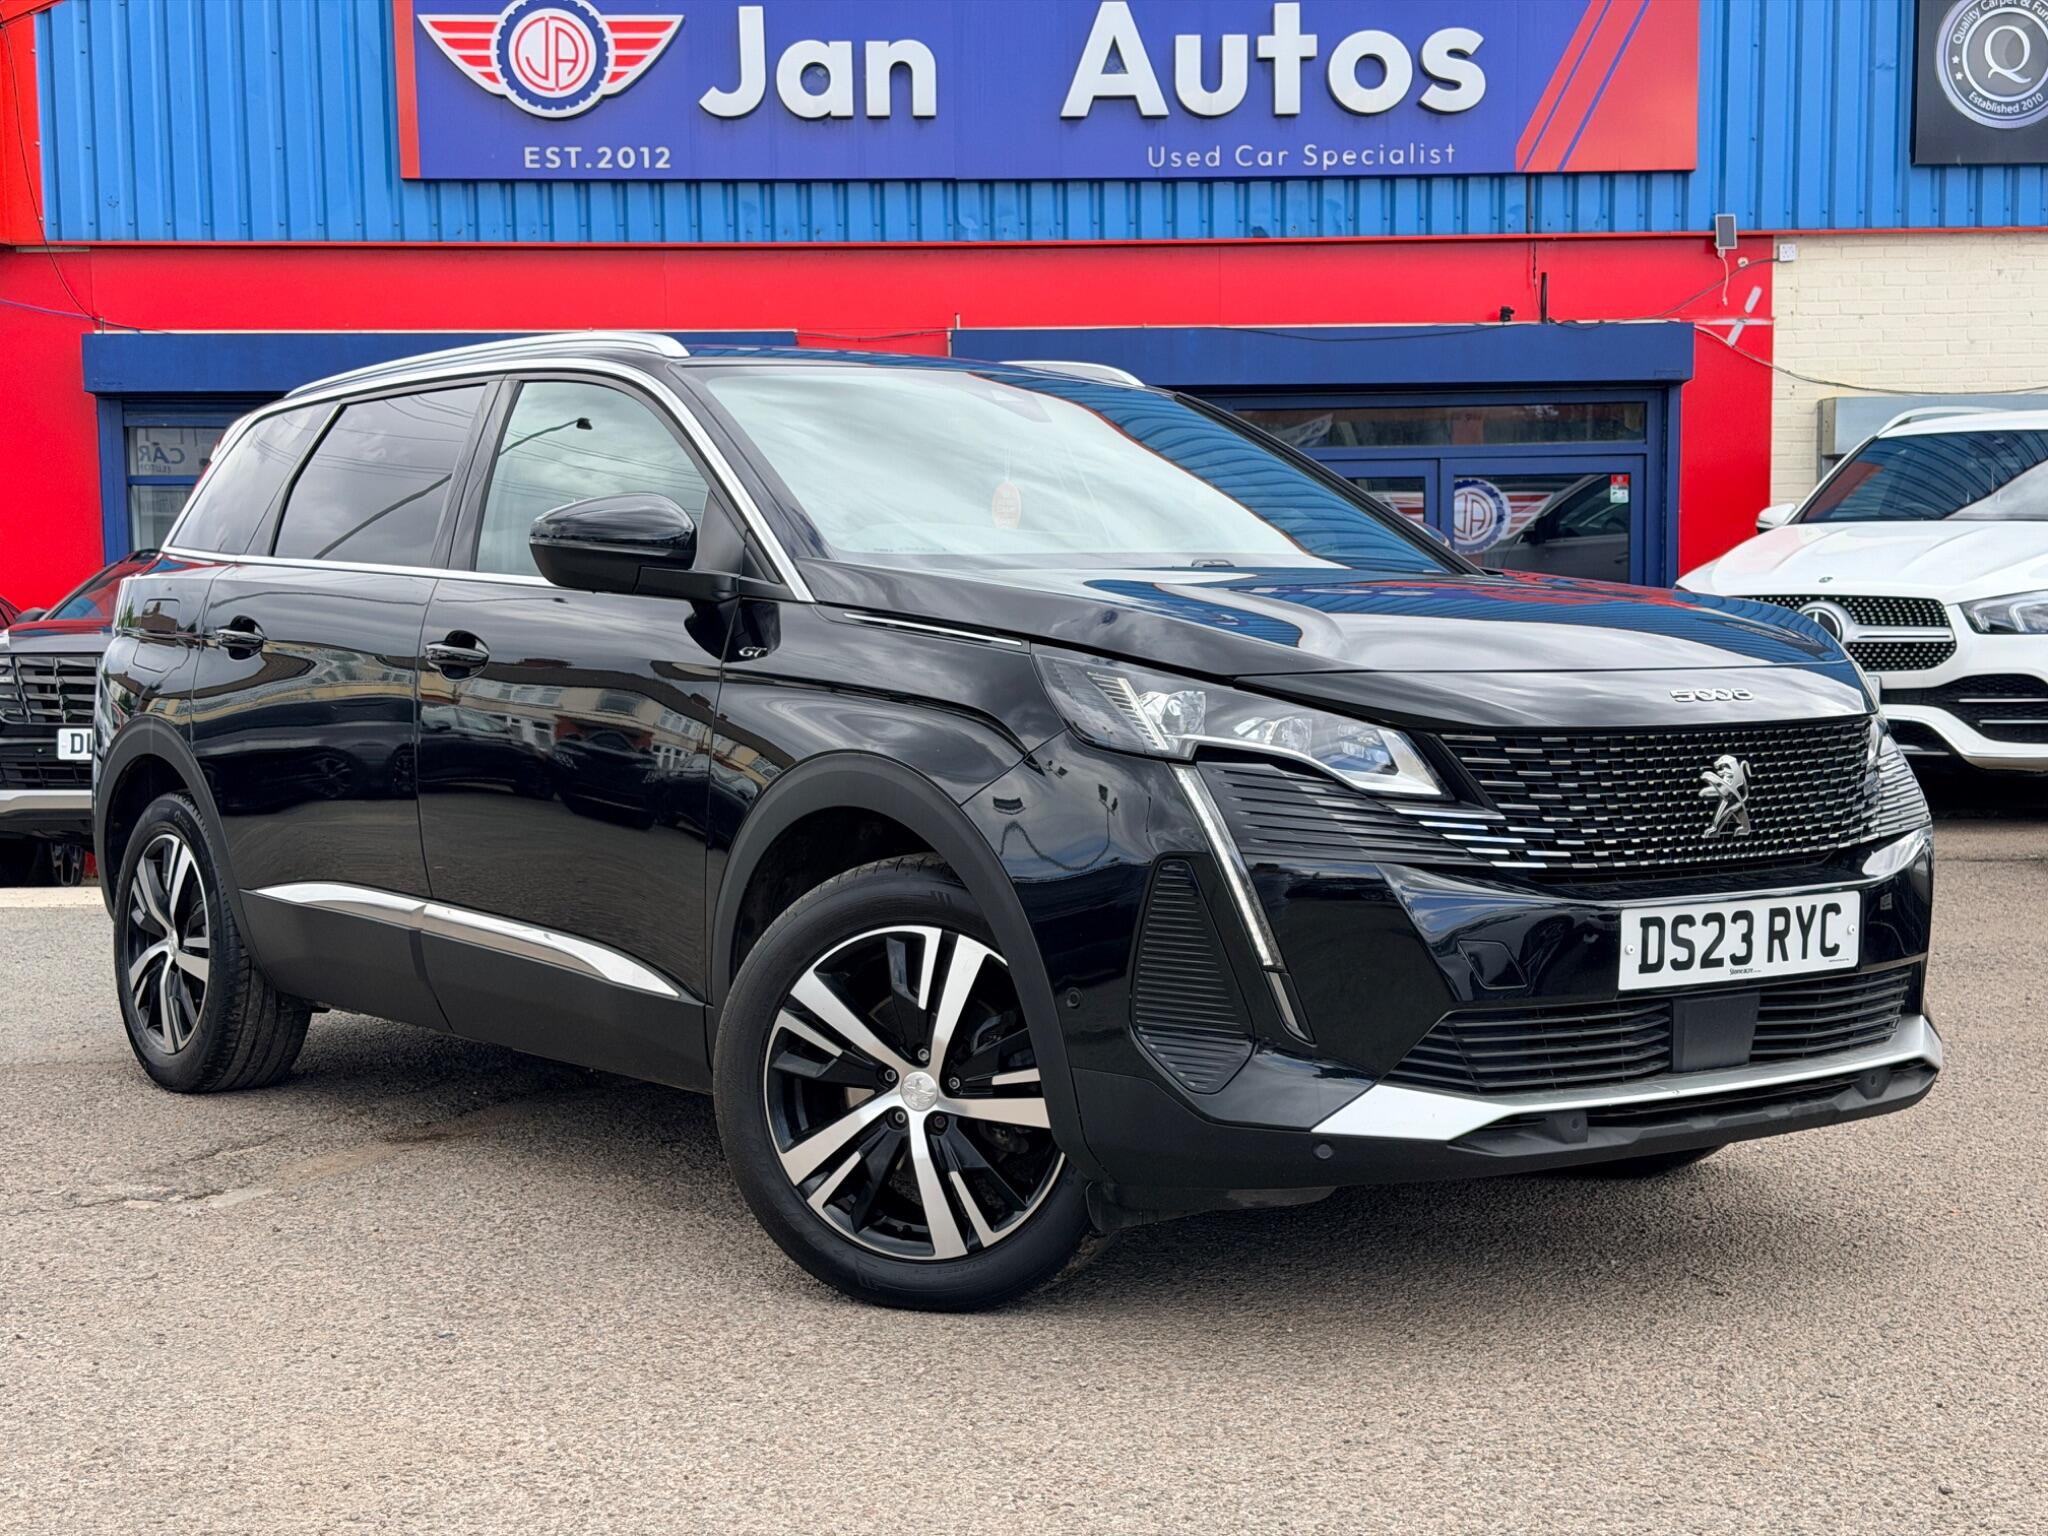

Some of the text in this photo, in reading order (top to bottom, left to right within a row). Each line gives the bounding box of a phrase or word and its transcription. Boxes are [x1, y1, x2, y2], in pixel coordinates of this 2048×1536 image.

[1952, 8, 1981, 45] Quality
[699, 0, 1487, 118] Jan Autos
[1984, 25, 2032, 84] Q
[1968, 91, 2044, 114] Established 2010
[1147, 142, 1456, 170] Used Car Specialist
[739, 646, 767, 658] GT
[1669, 688, 1754, 703] 5008
[1638, 902, 1842, 974] DS23 RYC
